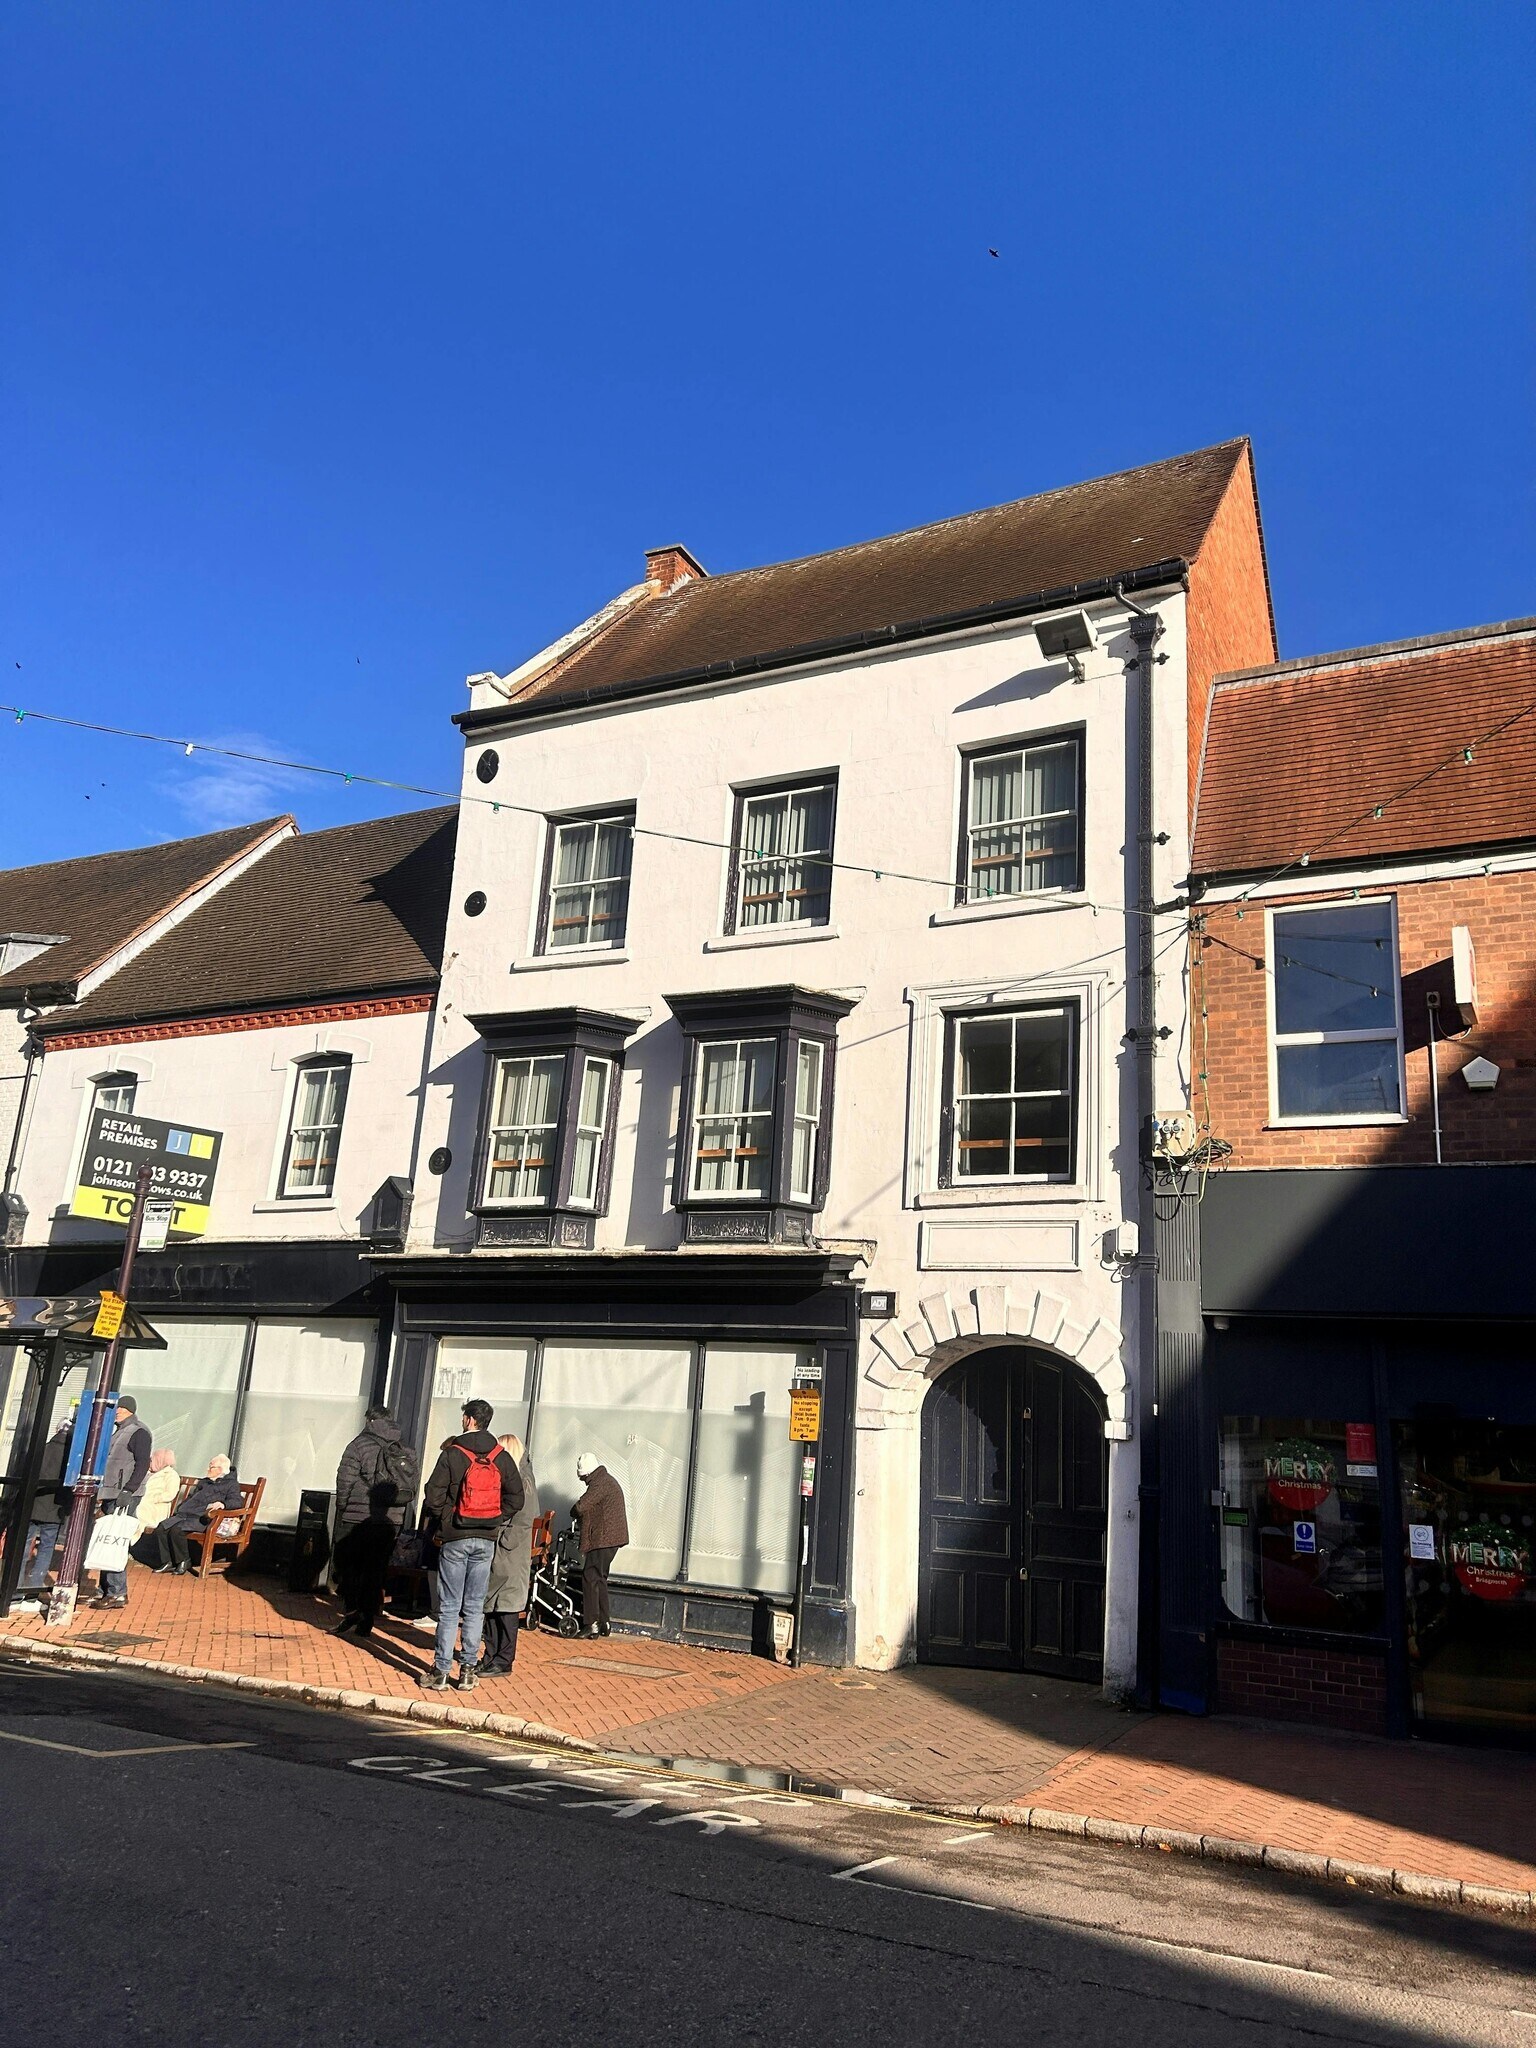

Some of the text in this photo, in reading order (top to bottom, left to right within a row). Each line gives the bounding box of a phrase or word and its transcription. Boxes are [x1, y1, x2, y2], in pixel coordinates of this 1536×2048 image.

[101, 1118, 143, 1136] RETAIL
[99, 1130, 158, 1150] PREMISES
[93, 1156, 133, 1176] 0121
[169, 1169, 208, 1188] 9337
[102, 1195, 134, 1218] TO
[1265, 1457, 1334, 1482] MERRY
[1278, 1479, 1322, 1491] Christmas
[96, 1534, 129, 1547] NEXT
[1450, 1542, 1529, 1571] MERRY
[1466, 1565, 1516, 1579] Christmas
[348, 1756, 762, 1835] CLEAR
